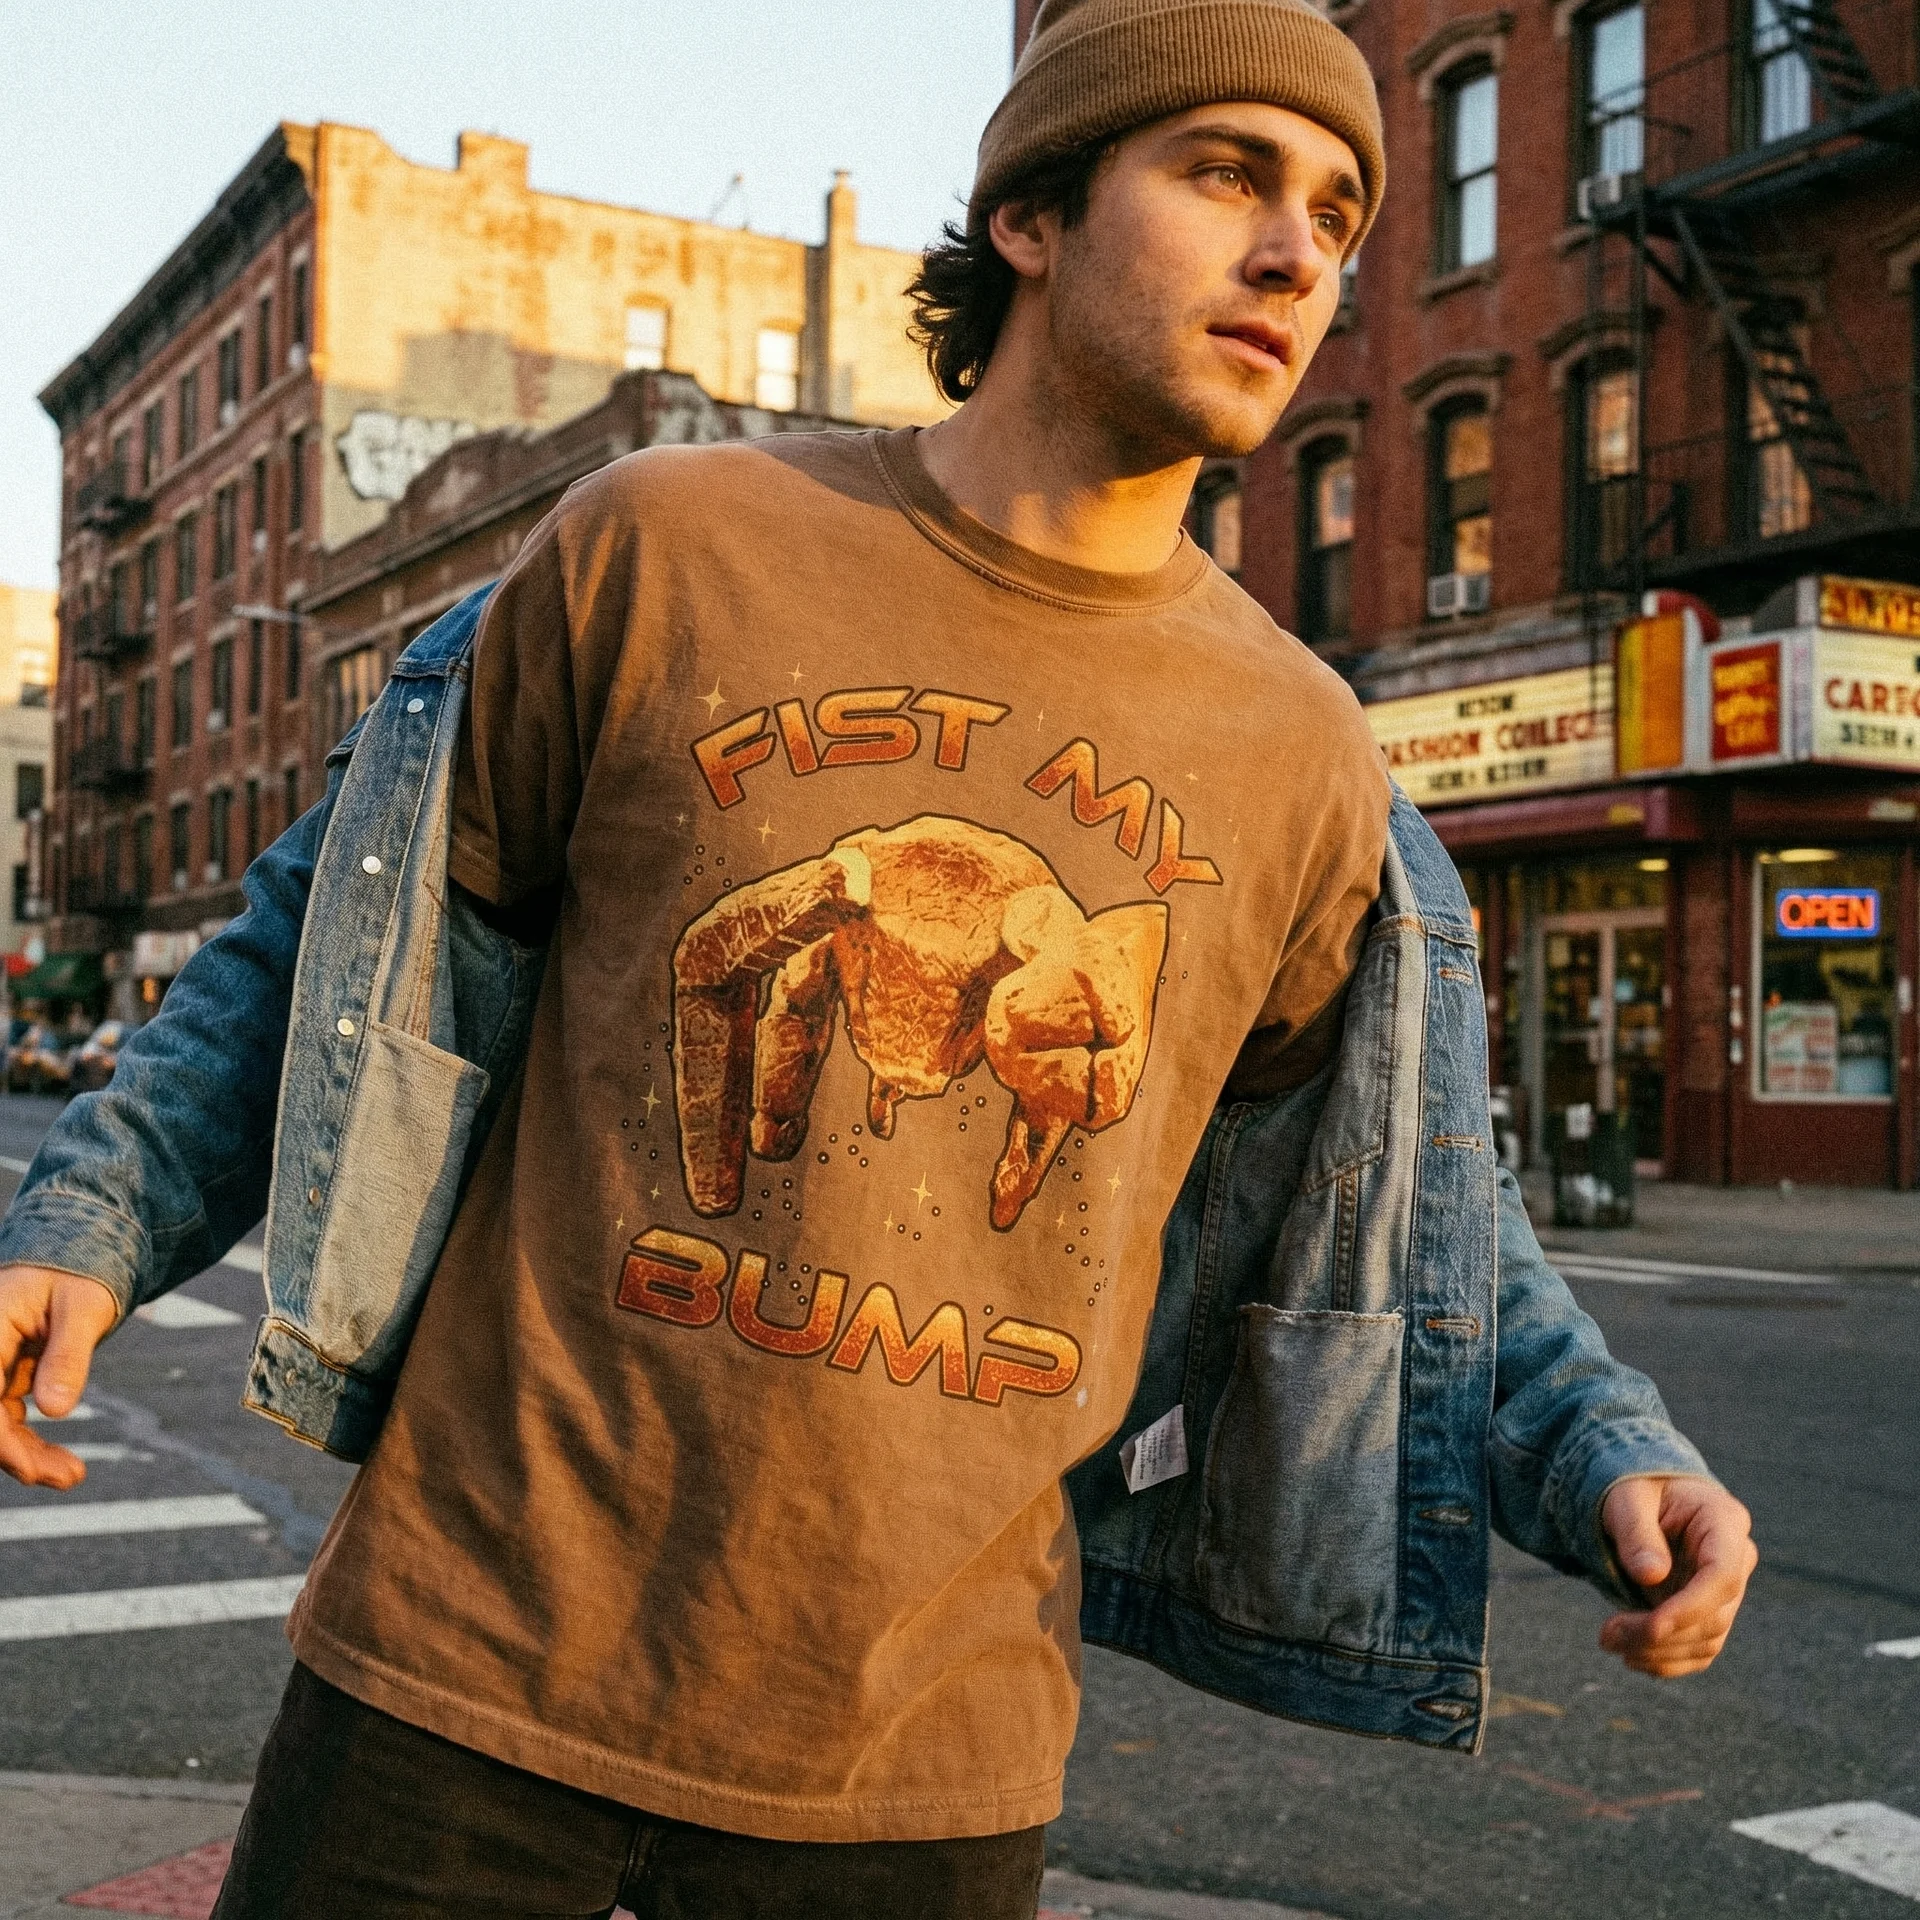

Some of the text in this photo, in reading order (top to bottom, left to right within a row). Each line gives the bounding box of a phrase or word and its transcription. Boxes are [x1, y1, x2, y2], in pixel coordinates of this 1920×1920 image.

[691, 686, 1224, 896] FIST MY
[1780, 895, 1875, 930] OPEN
[615, 1224, 1082, 1408] BUMP
